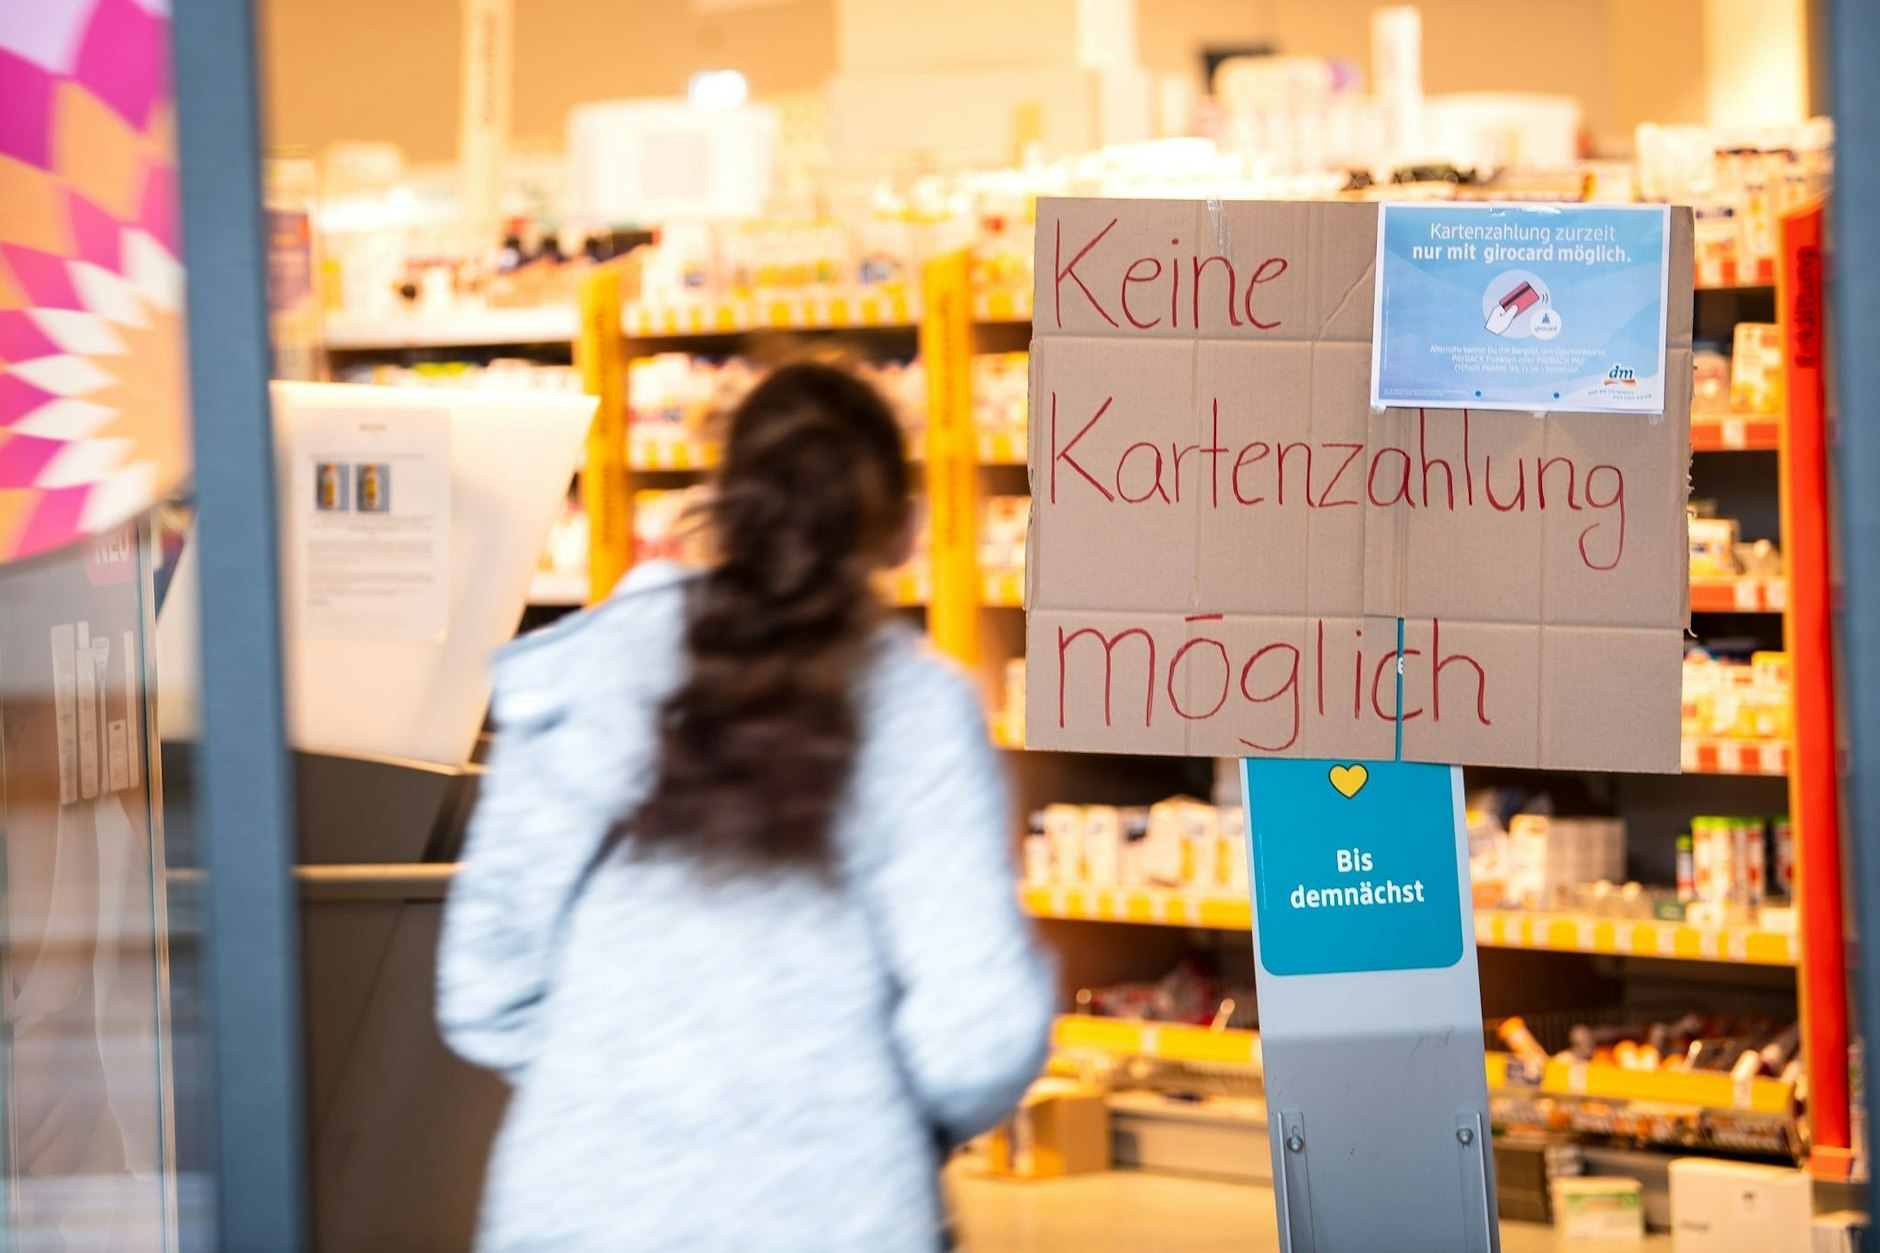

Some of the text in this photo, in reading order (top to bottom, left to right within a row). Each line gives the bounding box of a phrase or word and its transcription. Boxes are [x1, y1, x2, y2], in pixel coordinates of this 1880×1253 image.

[1430, 222, 1616, 244] Kartenzahlung zurzeit
[1412, 243, 1631, 266] nur mit girocard möglich.
[1055, 218, 1289, 330] Keine
[1608, 365, 1634, 379] dm
[1050, 392, 1625, 570] Kartenzahlung
[1058, 613, 1491, 751] möglich
[1336, 848, 1373, 873] Bis
[1290, 880, 1425, 909] demnächst
